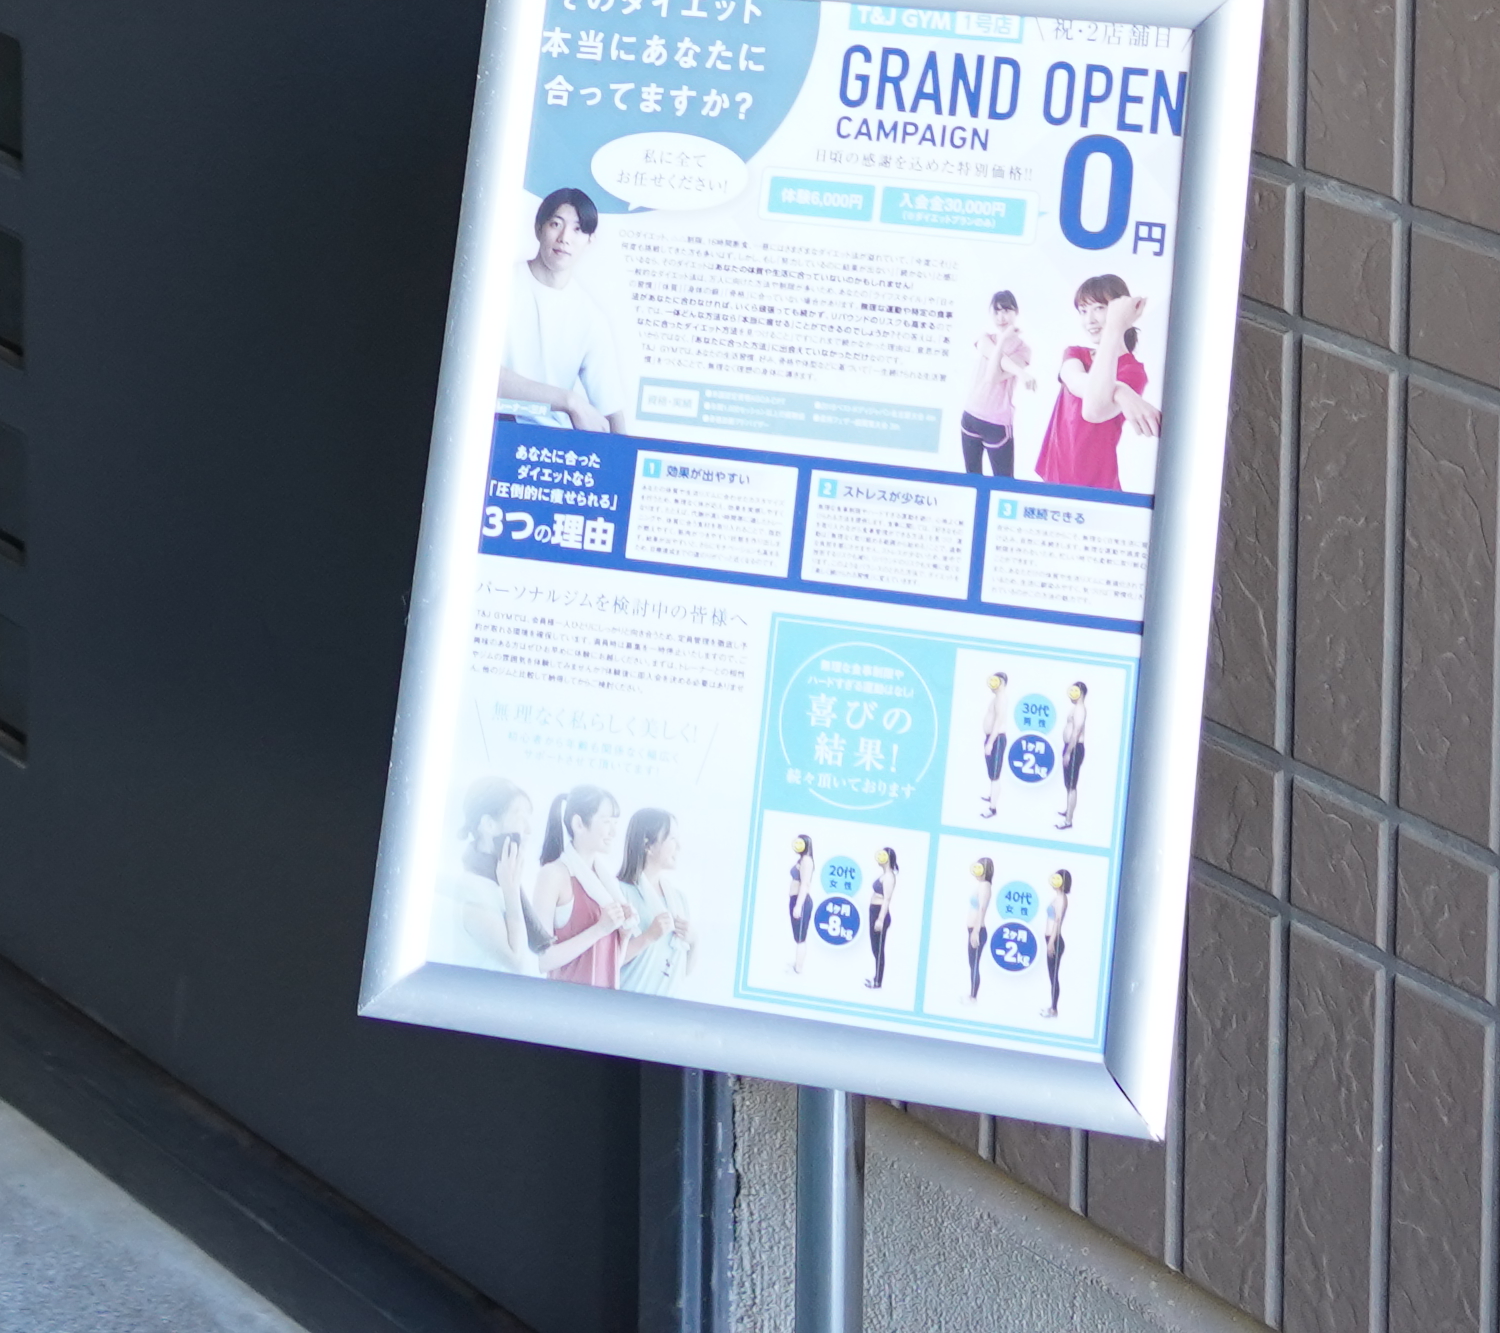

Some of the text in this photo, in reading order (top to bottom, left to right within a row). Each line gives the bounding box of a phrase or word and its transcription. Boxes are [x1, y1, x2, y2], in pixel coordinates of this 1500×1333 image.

[900, 7, 952, 31] GYM
[539, 25, 767, 75] 本当にあなたに
[542, 73, 753, 122] 合ってますか?
[836, 42, 1187, 137] GRAND OPEN
[834, 115, 990, 152] CAMPAIGN
[642, 147, 707, 169] 私に全て
[515, 444, 601, 468] あなたに合った
[516, 463, 595, 487] ダイエットなら
[665, 464, 751, 486] 効果が出やすい
[842, 484, 938, 508] ストレスが少ない
[481, 503, 615, 553] 3つの理由
[804, 691, 914, 739] 喜びの
[1021, 701, 1050, 718] 30代
[813, 730, 899, 775] 結果!
[785, 766, 916, 800] 続々頂いております
[828, 863, 856, 880] 20代
[1004, 888, 1032, 906] 40代
